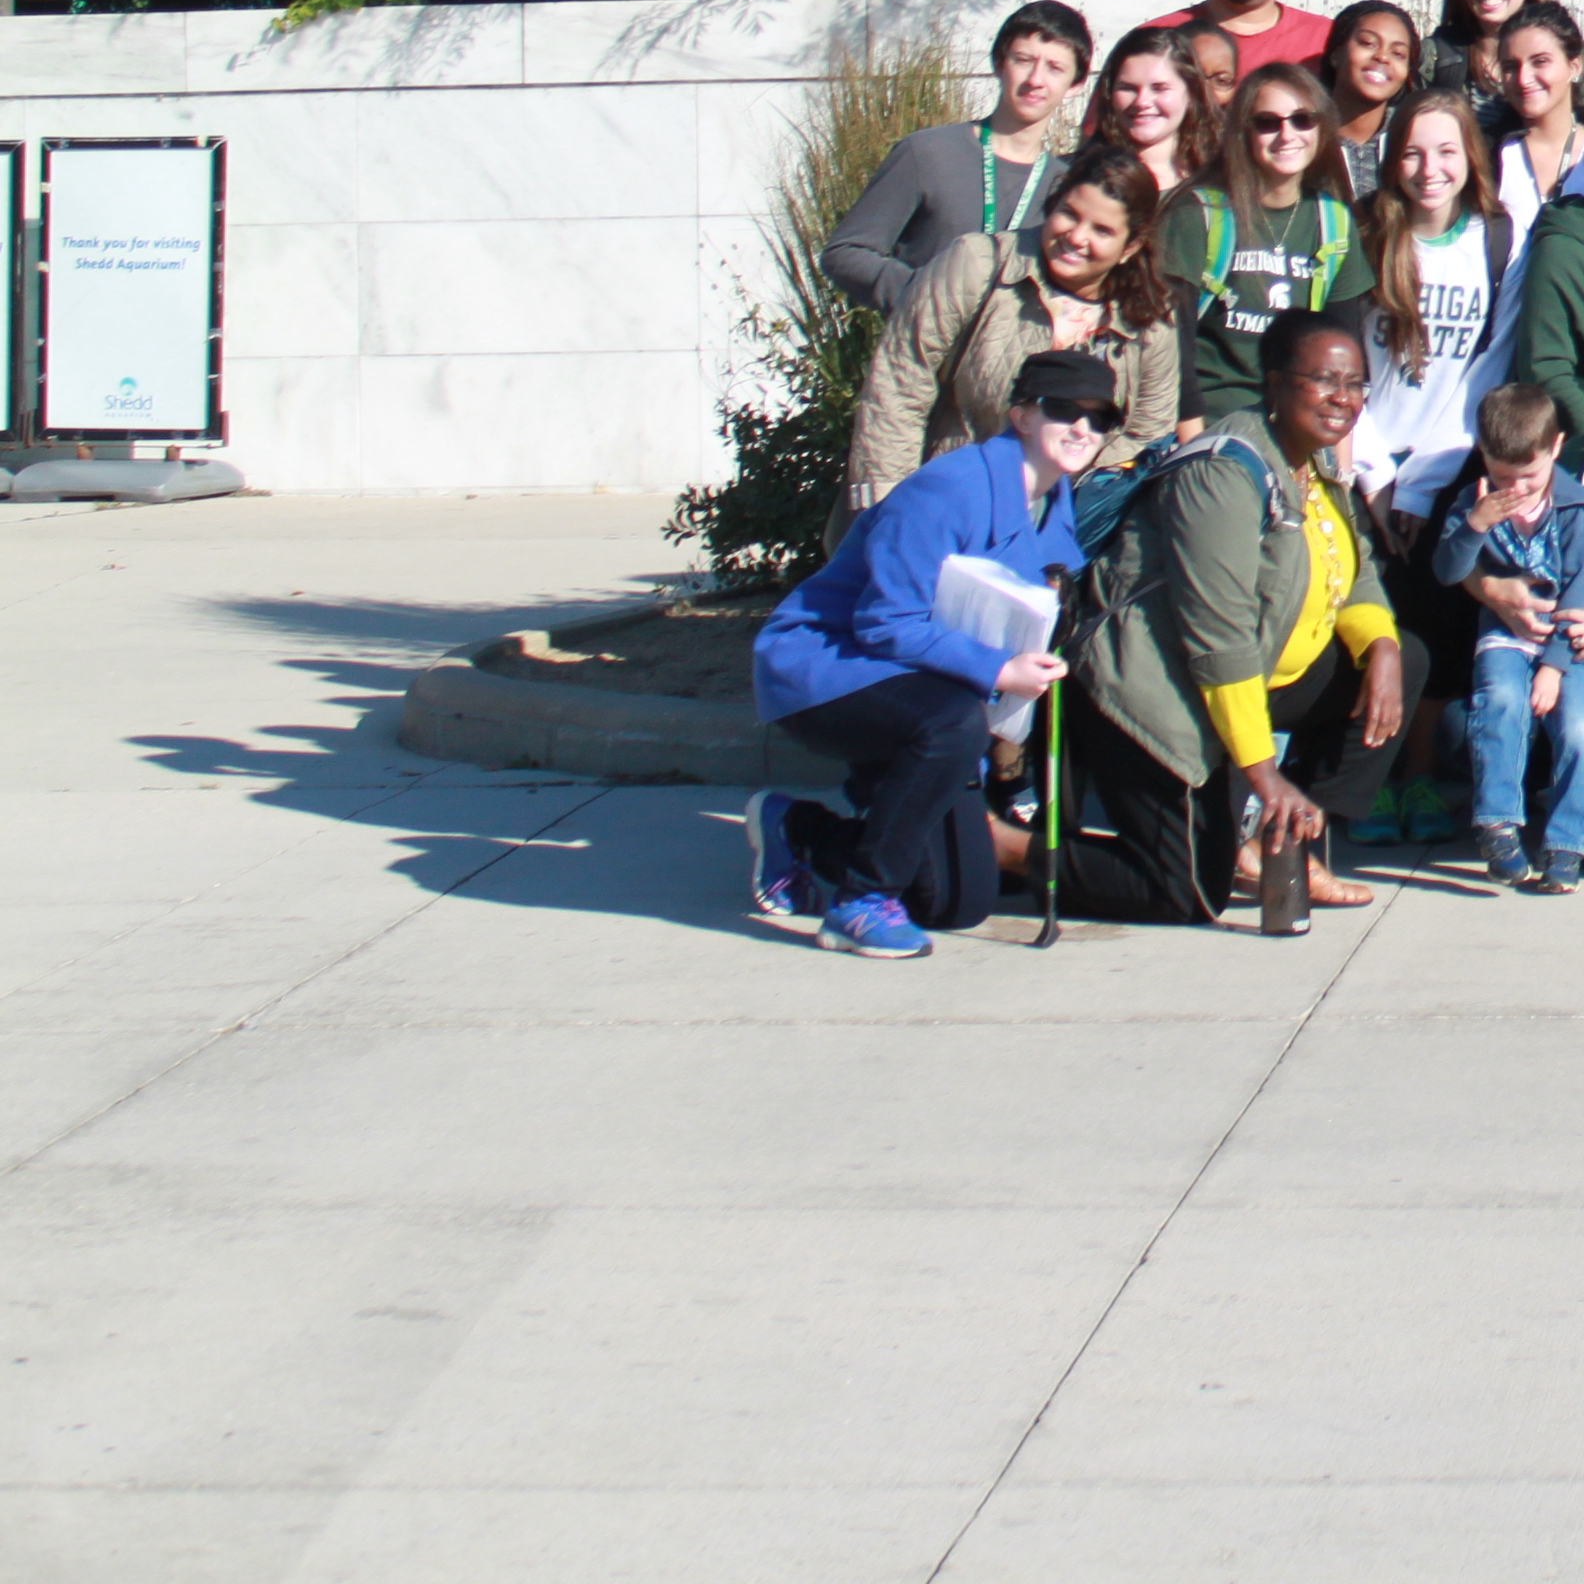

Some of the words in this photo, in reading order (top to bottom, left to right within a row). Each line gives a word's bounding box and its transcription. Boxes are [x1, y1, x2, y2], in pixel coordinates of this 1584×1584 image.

[62, 236, 100, 248] Thank
[101, 240, 128, 252] you
[129, 236, 150, 252] for
[153, 237, 201, 253] visiting
[75, 258, 115, 270] Shedd
[116, 258, 186, 273] Aquarium!
[104, 394, 153, 411] Shedd
